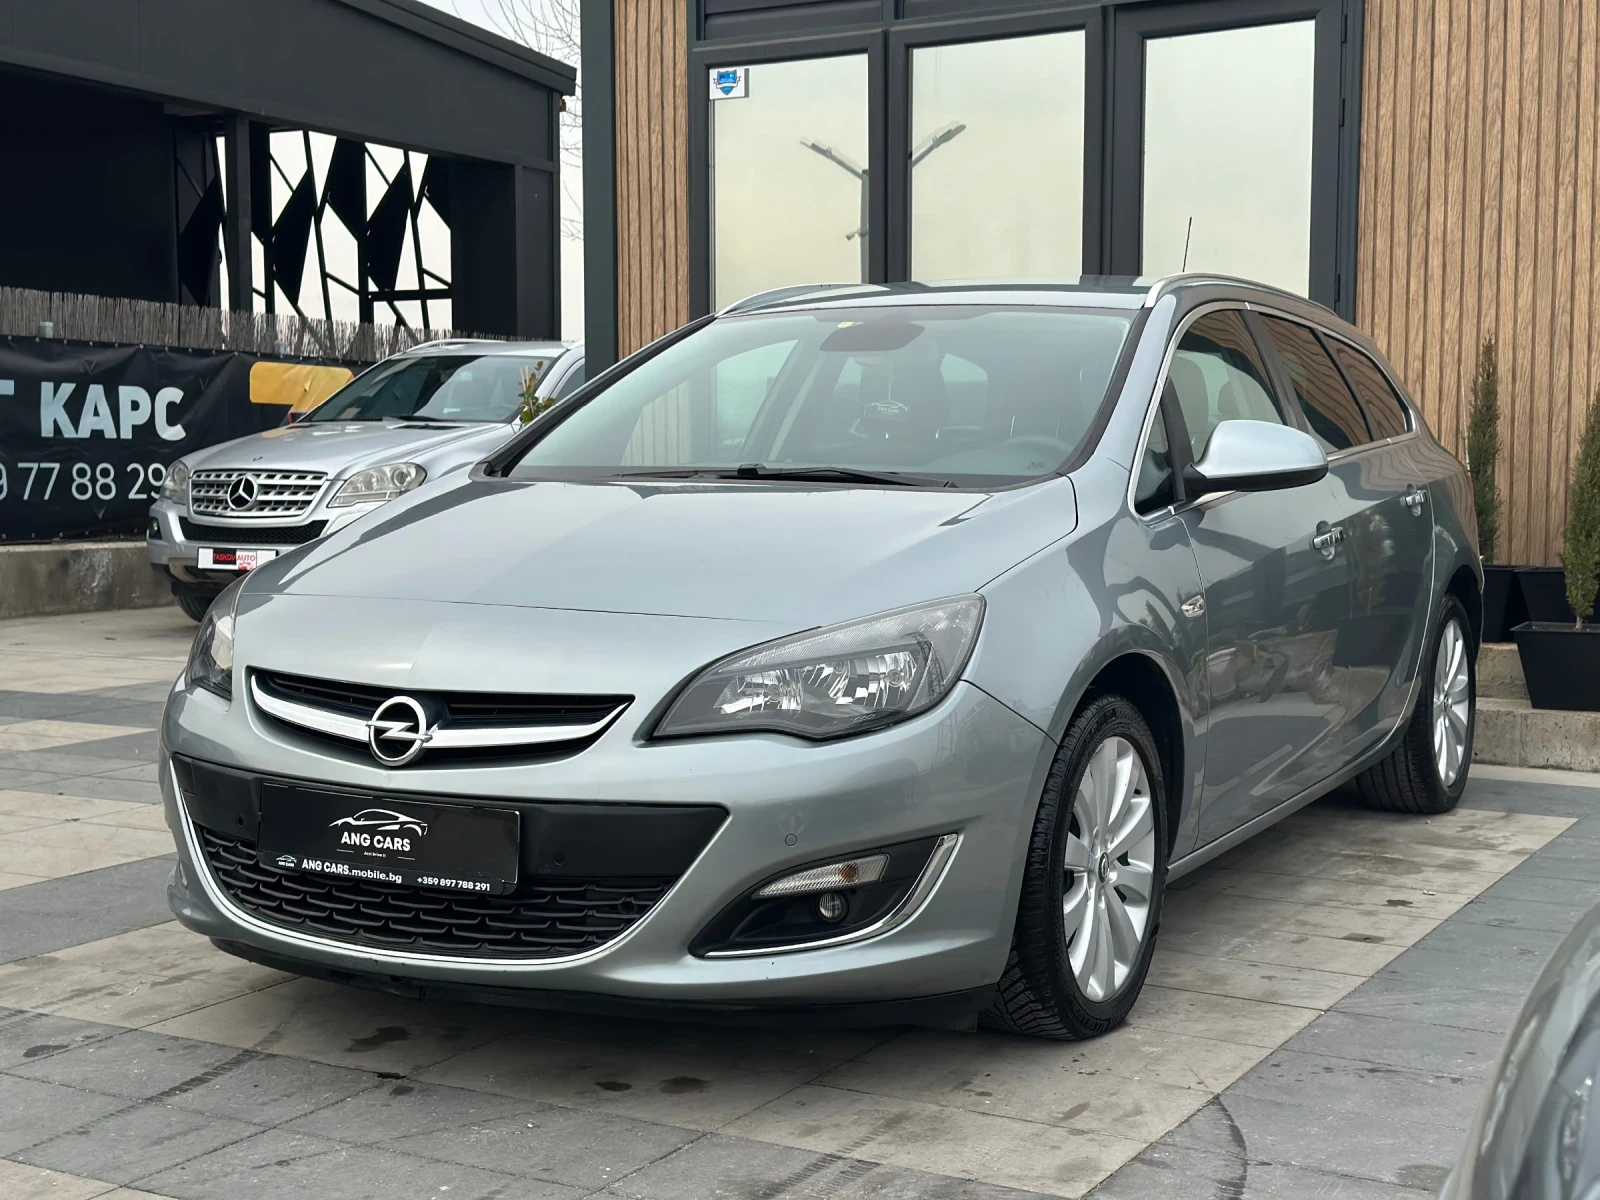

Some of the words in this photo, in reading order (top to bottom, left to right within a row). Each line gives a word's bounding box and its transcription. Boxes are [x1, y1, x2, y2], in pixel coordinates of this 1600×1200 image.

[40, 381, 186, 441] КАРС
[17, 462, 60, 500] 77
[71, 462, 116, 500] 88
[213, 553, 236, 561] TASKOV
[236, 554, 256, 562] AUTO
[340, 831, 371, 847] ANG
[373, 835, 411, 852] CARS
[301, 859, 322, 871] ANG
[323, 862, 402, 883] CARS.mobile.bg
[417, 876, 439, 886] +359
[440, 878, 456, 888] 897
[457, 880, 474, 890] 788
[475, 882, 491, 892] 291
